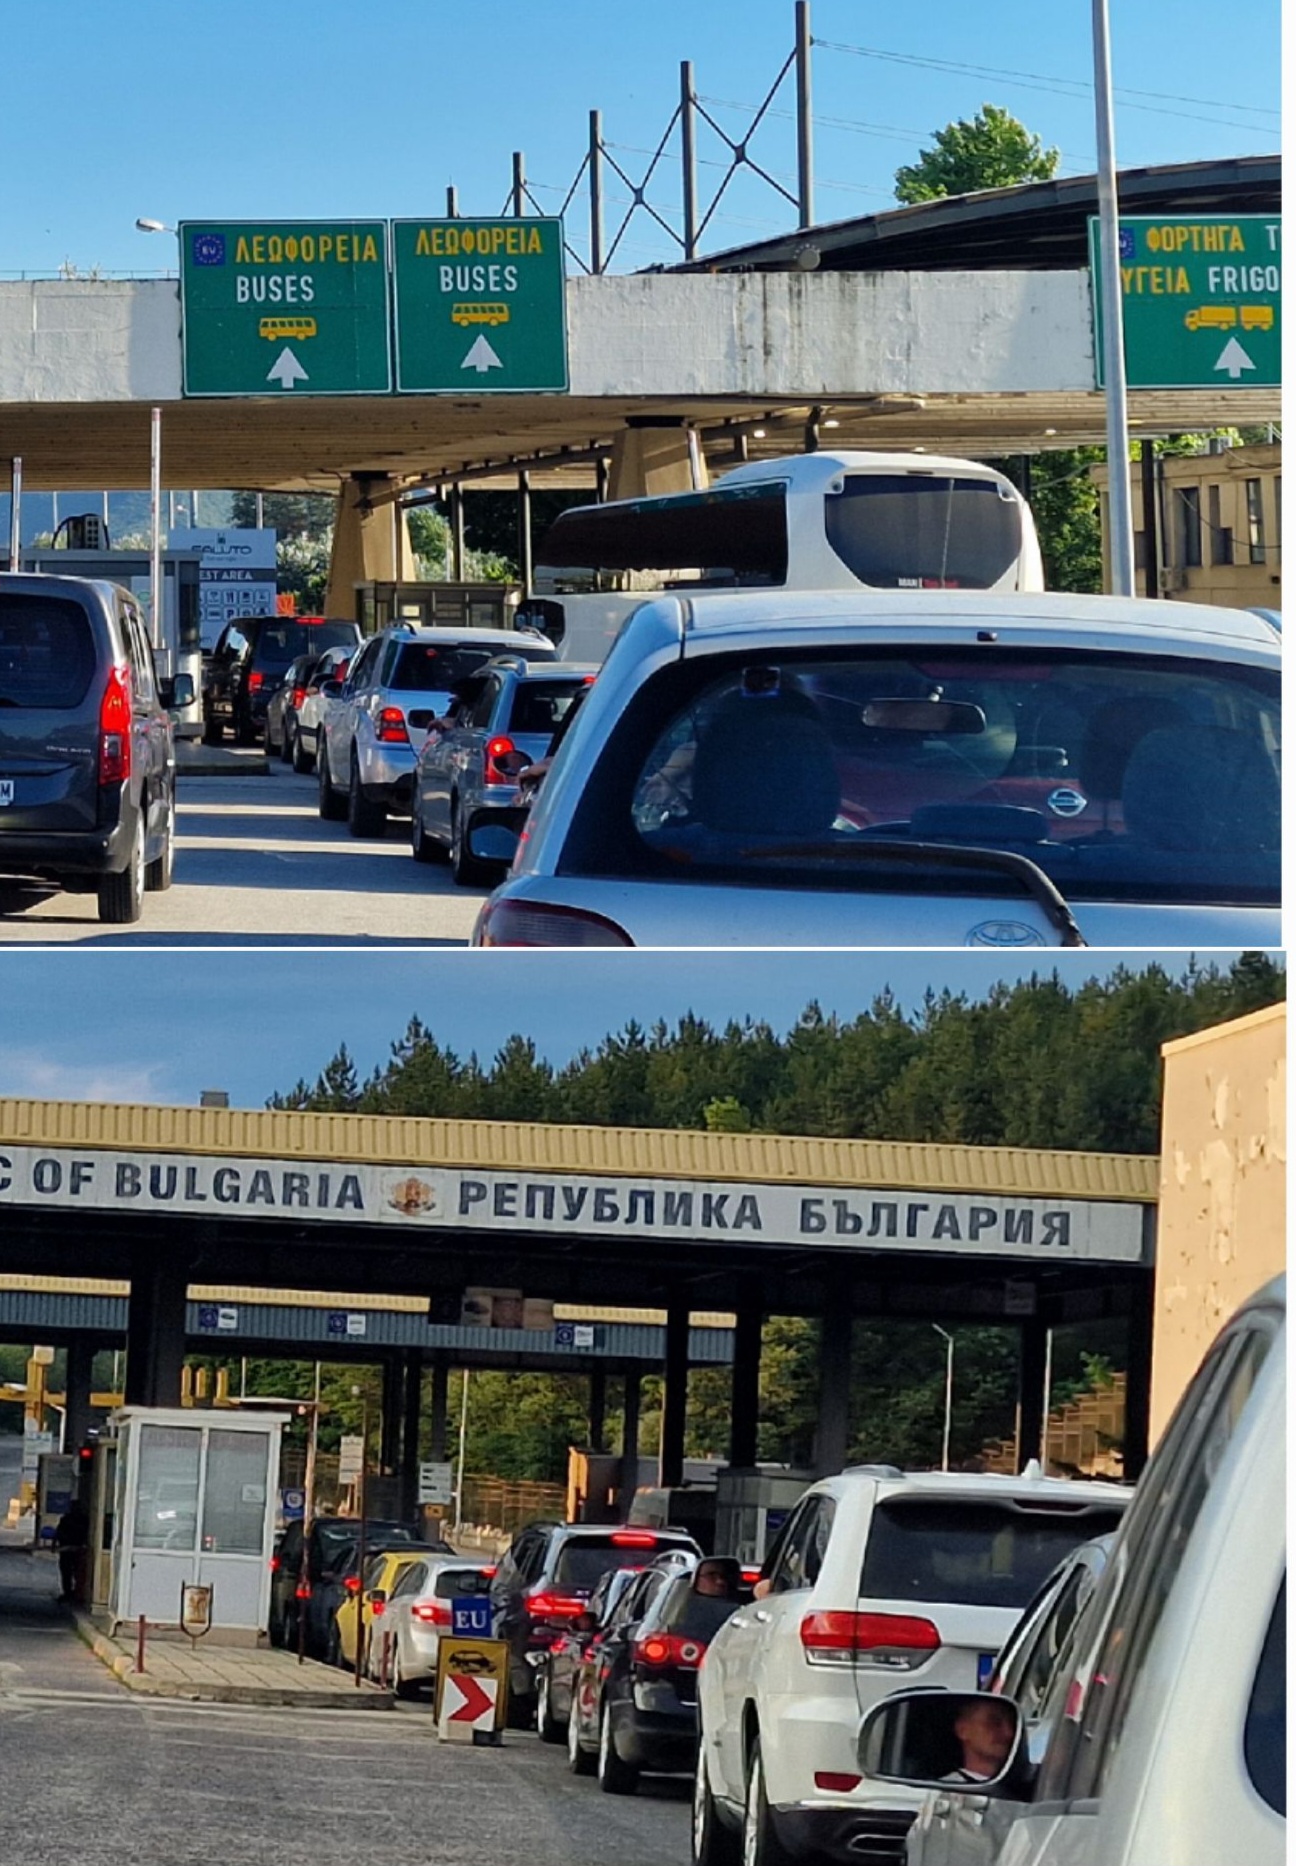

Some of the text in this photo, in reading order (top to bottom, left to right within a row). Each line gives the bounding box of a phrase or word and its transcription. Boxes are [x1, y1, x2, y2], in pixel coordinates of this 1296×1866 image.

[235, 235, 378, 263] ΛΕΩΦΟΡΕΙΑ
[415, 227, 543, 255] ΛΕΩΦΟΡΕΙΑ
[1146, 225, 1245, 252] ΦΟΡΤΗΓΑ
[236, 275, 315, 303] BUSES
[439, 265, 518, 292] BUSES
[1121, 265, 1279, 294] ΥΓΕΙΑ FRIGO
[199, 570, 253, 580] EST AREA
[33, 1158, 96, 1193] OF
[115, 1162, 366, 1210] BULGARIA
[458, 1180, 1072, 1246] РЕПУБЛИКА БЪЛГАРИЯ
[456, 1611, 486, 1628] EU
